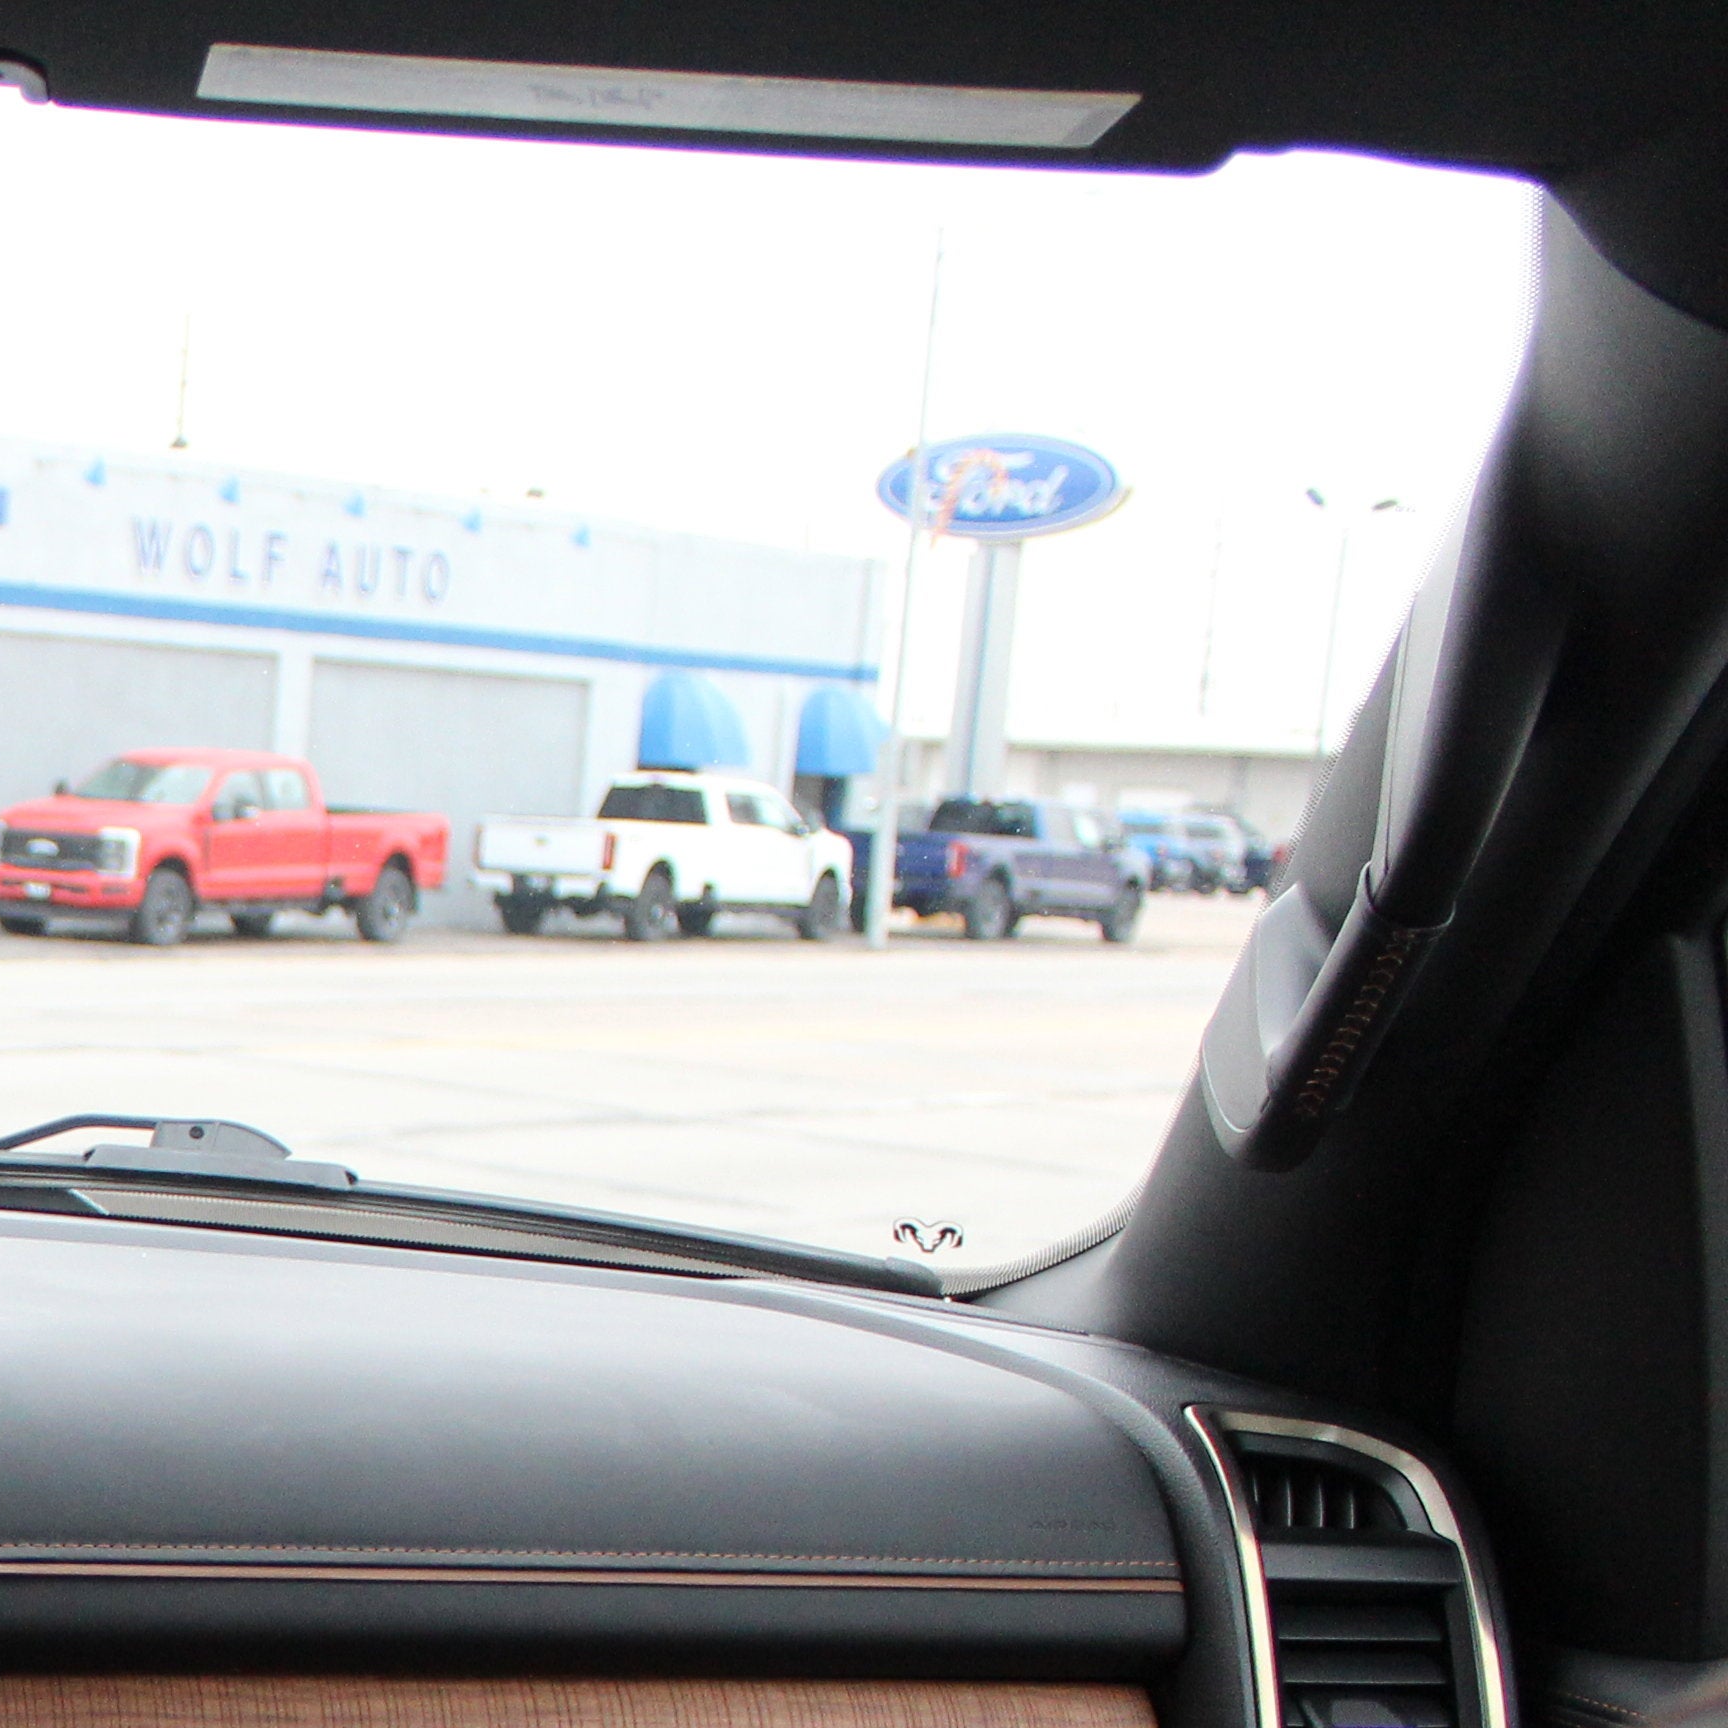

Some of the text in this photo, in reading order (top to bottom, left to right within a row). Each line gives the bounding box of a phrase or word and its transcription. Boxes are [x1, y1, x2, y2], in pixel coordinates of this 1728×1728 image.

[920, 448, 1070, 516] Ford
[132, 515, 451, 606] WOLF AUTO
